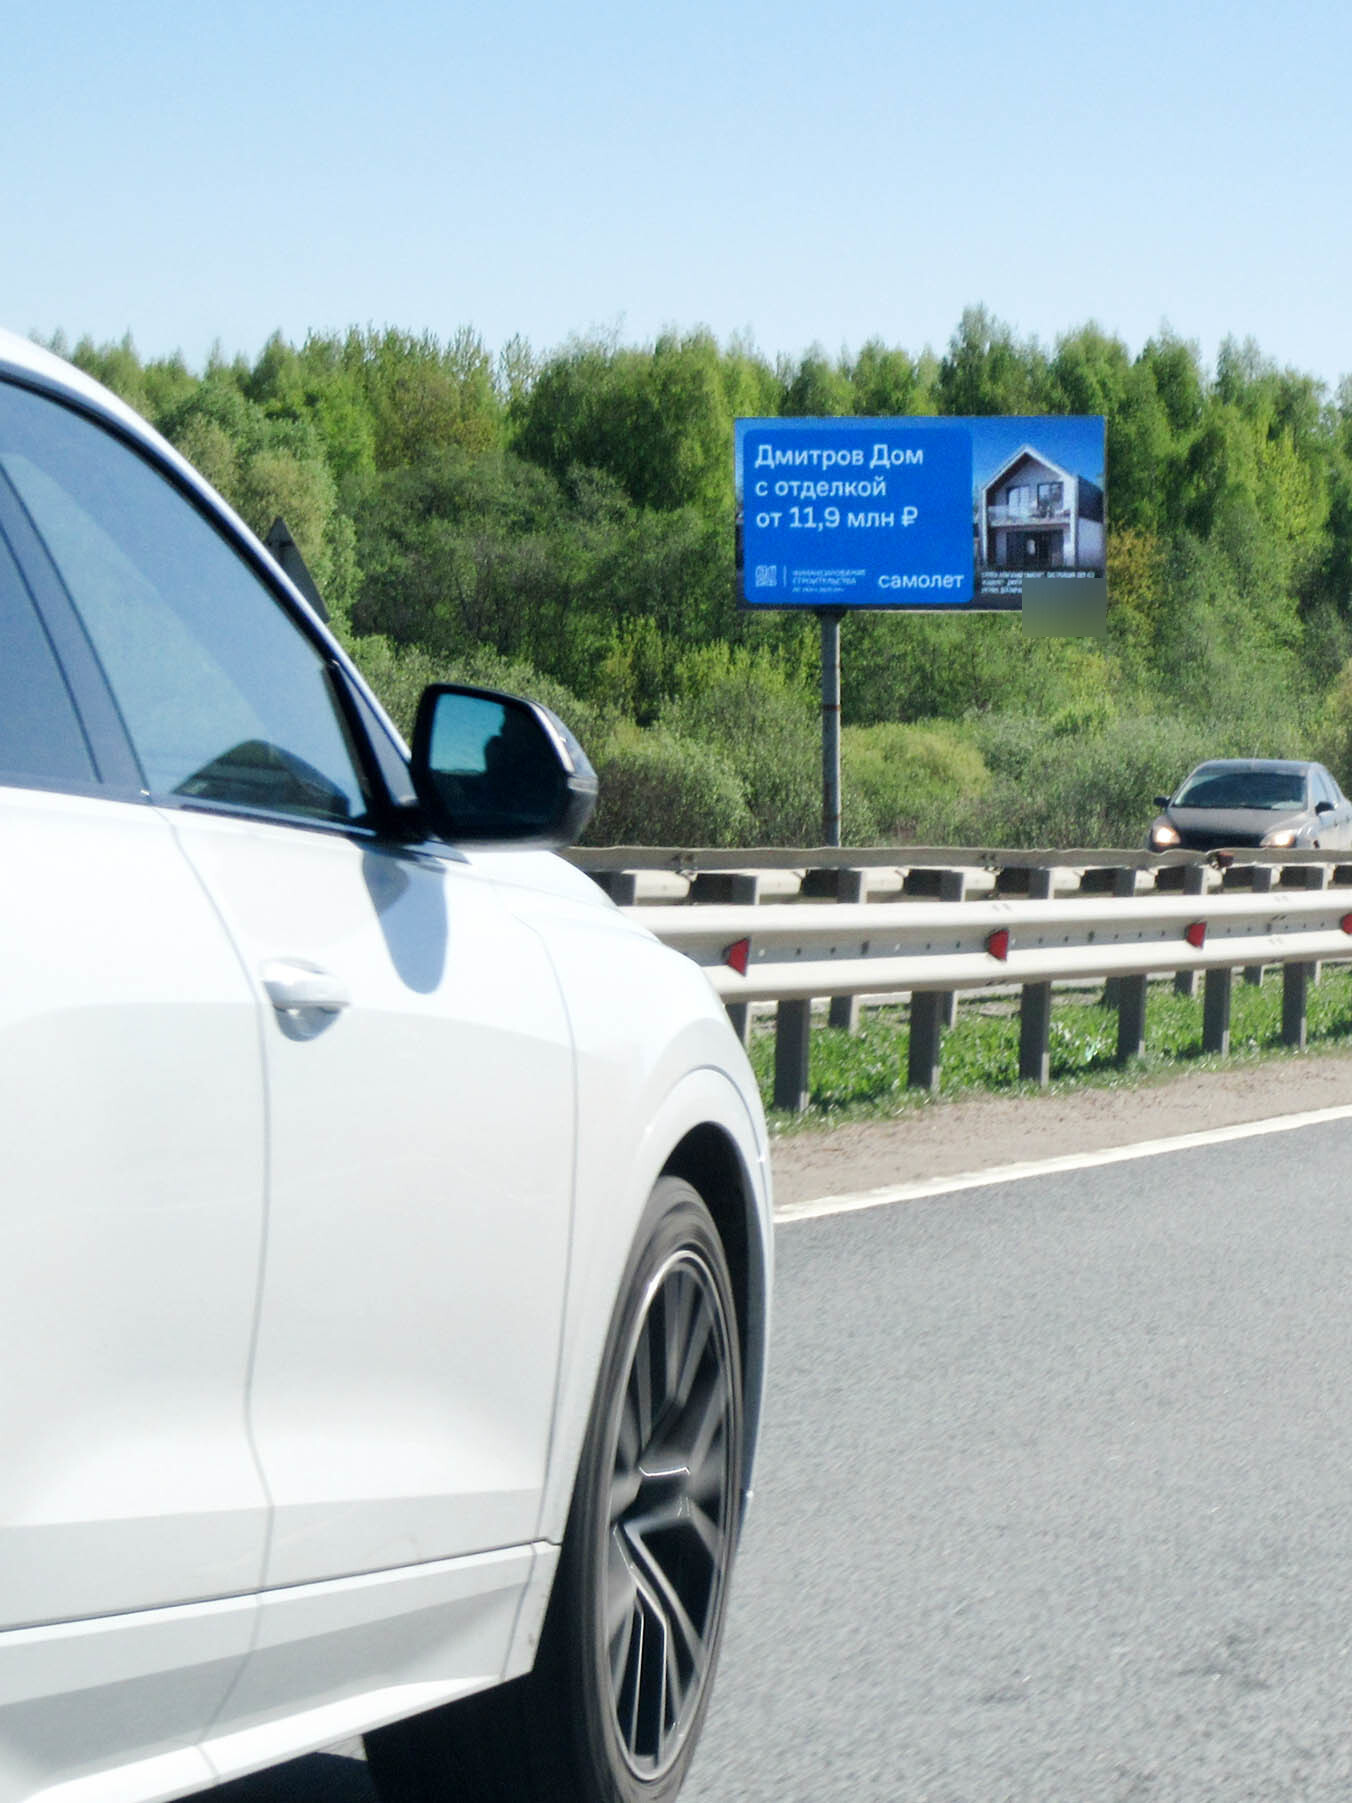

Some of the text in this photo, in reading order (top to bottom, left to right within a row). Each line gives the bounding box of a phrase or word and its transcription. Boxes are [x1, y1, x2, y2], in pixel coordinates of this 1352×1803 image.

[754, 444, 924, 471] Дмитров Дом
[755, 475, 887, 500] с отделкой
[756, 512, 783, 528] от
[788, 506, 841, 532] 11,9
[847, 511, 895, 528] млн
[878, 573, 965, 590] самолет
